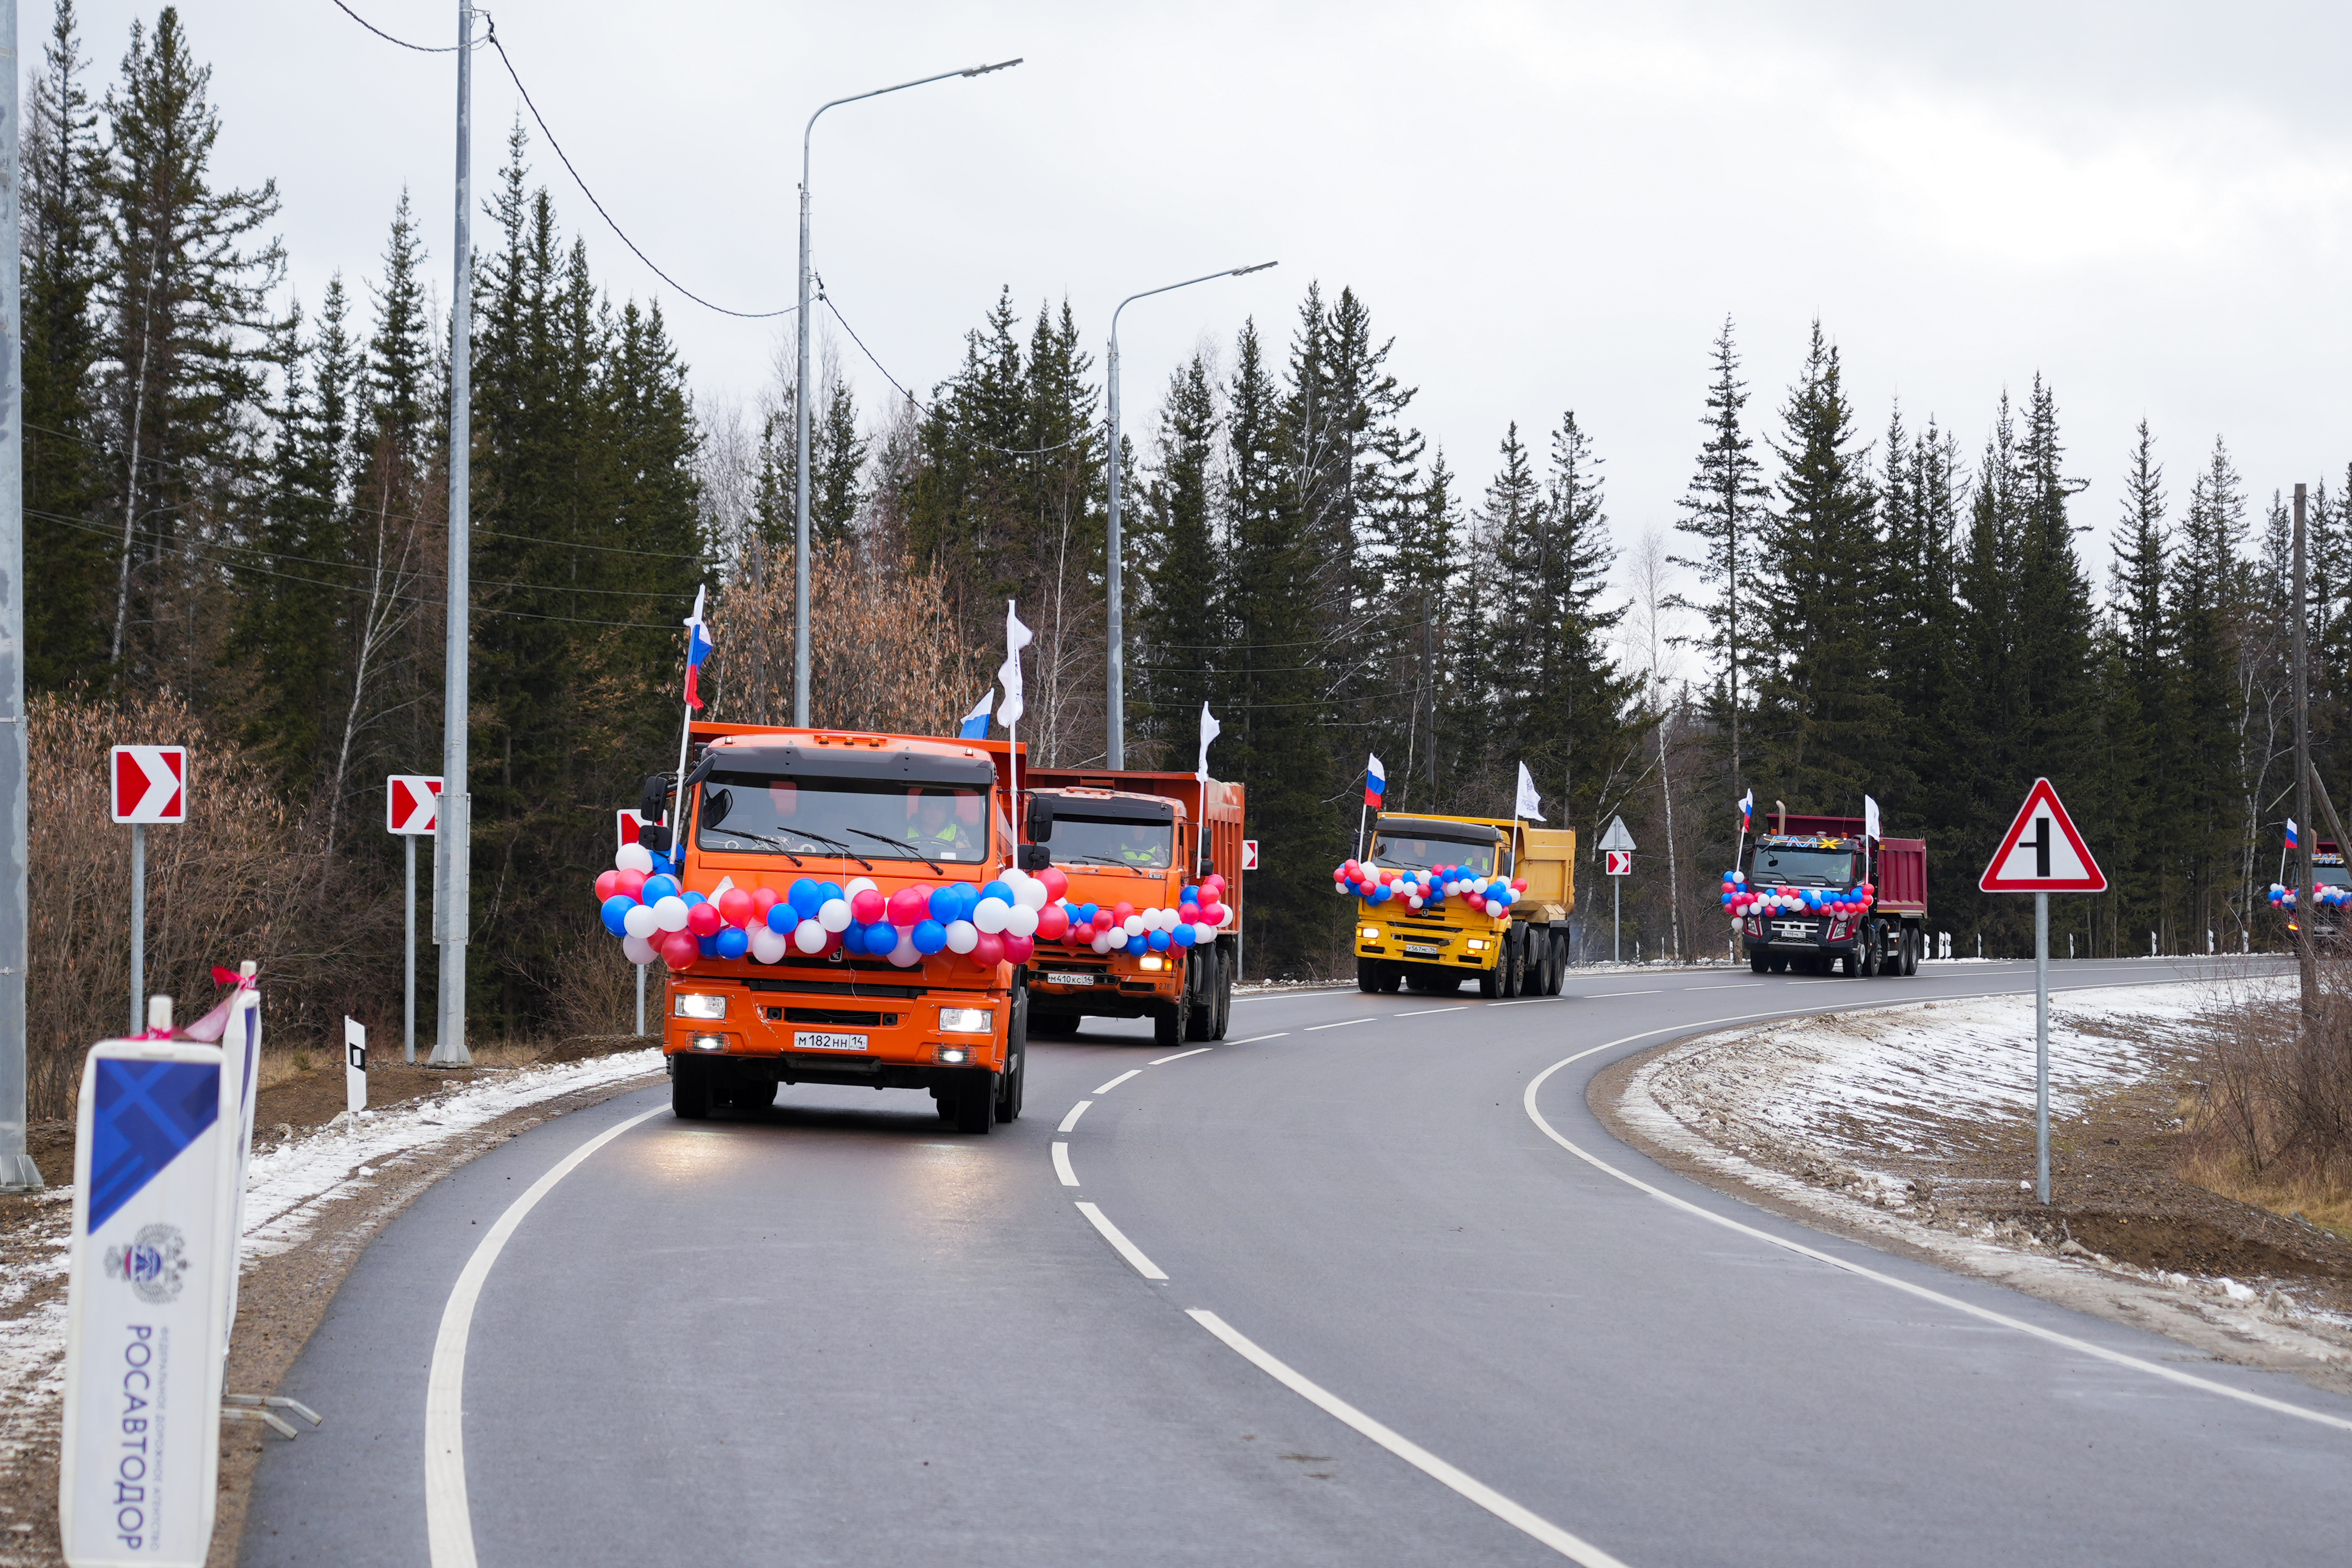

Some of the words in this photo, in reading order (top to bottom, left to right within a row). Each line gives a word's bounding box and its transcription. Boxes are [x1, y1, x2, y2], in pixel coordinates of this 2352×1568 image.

[1769, 836, 1840, 849] FMX
[1050, 975, 1082, 984] М410КС
[798, 1035, 847, 1048] М182НН
[851, 1036, 863, 1045] 14
[113, 1325, 152, 1550] РОСАВТОДОР
